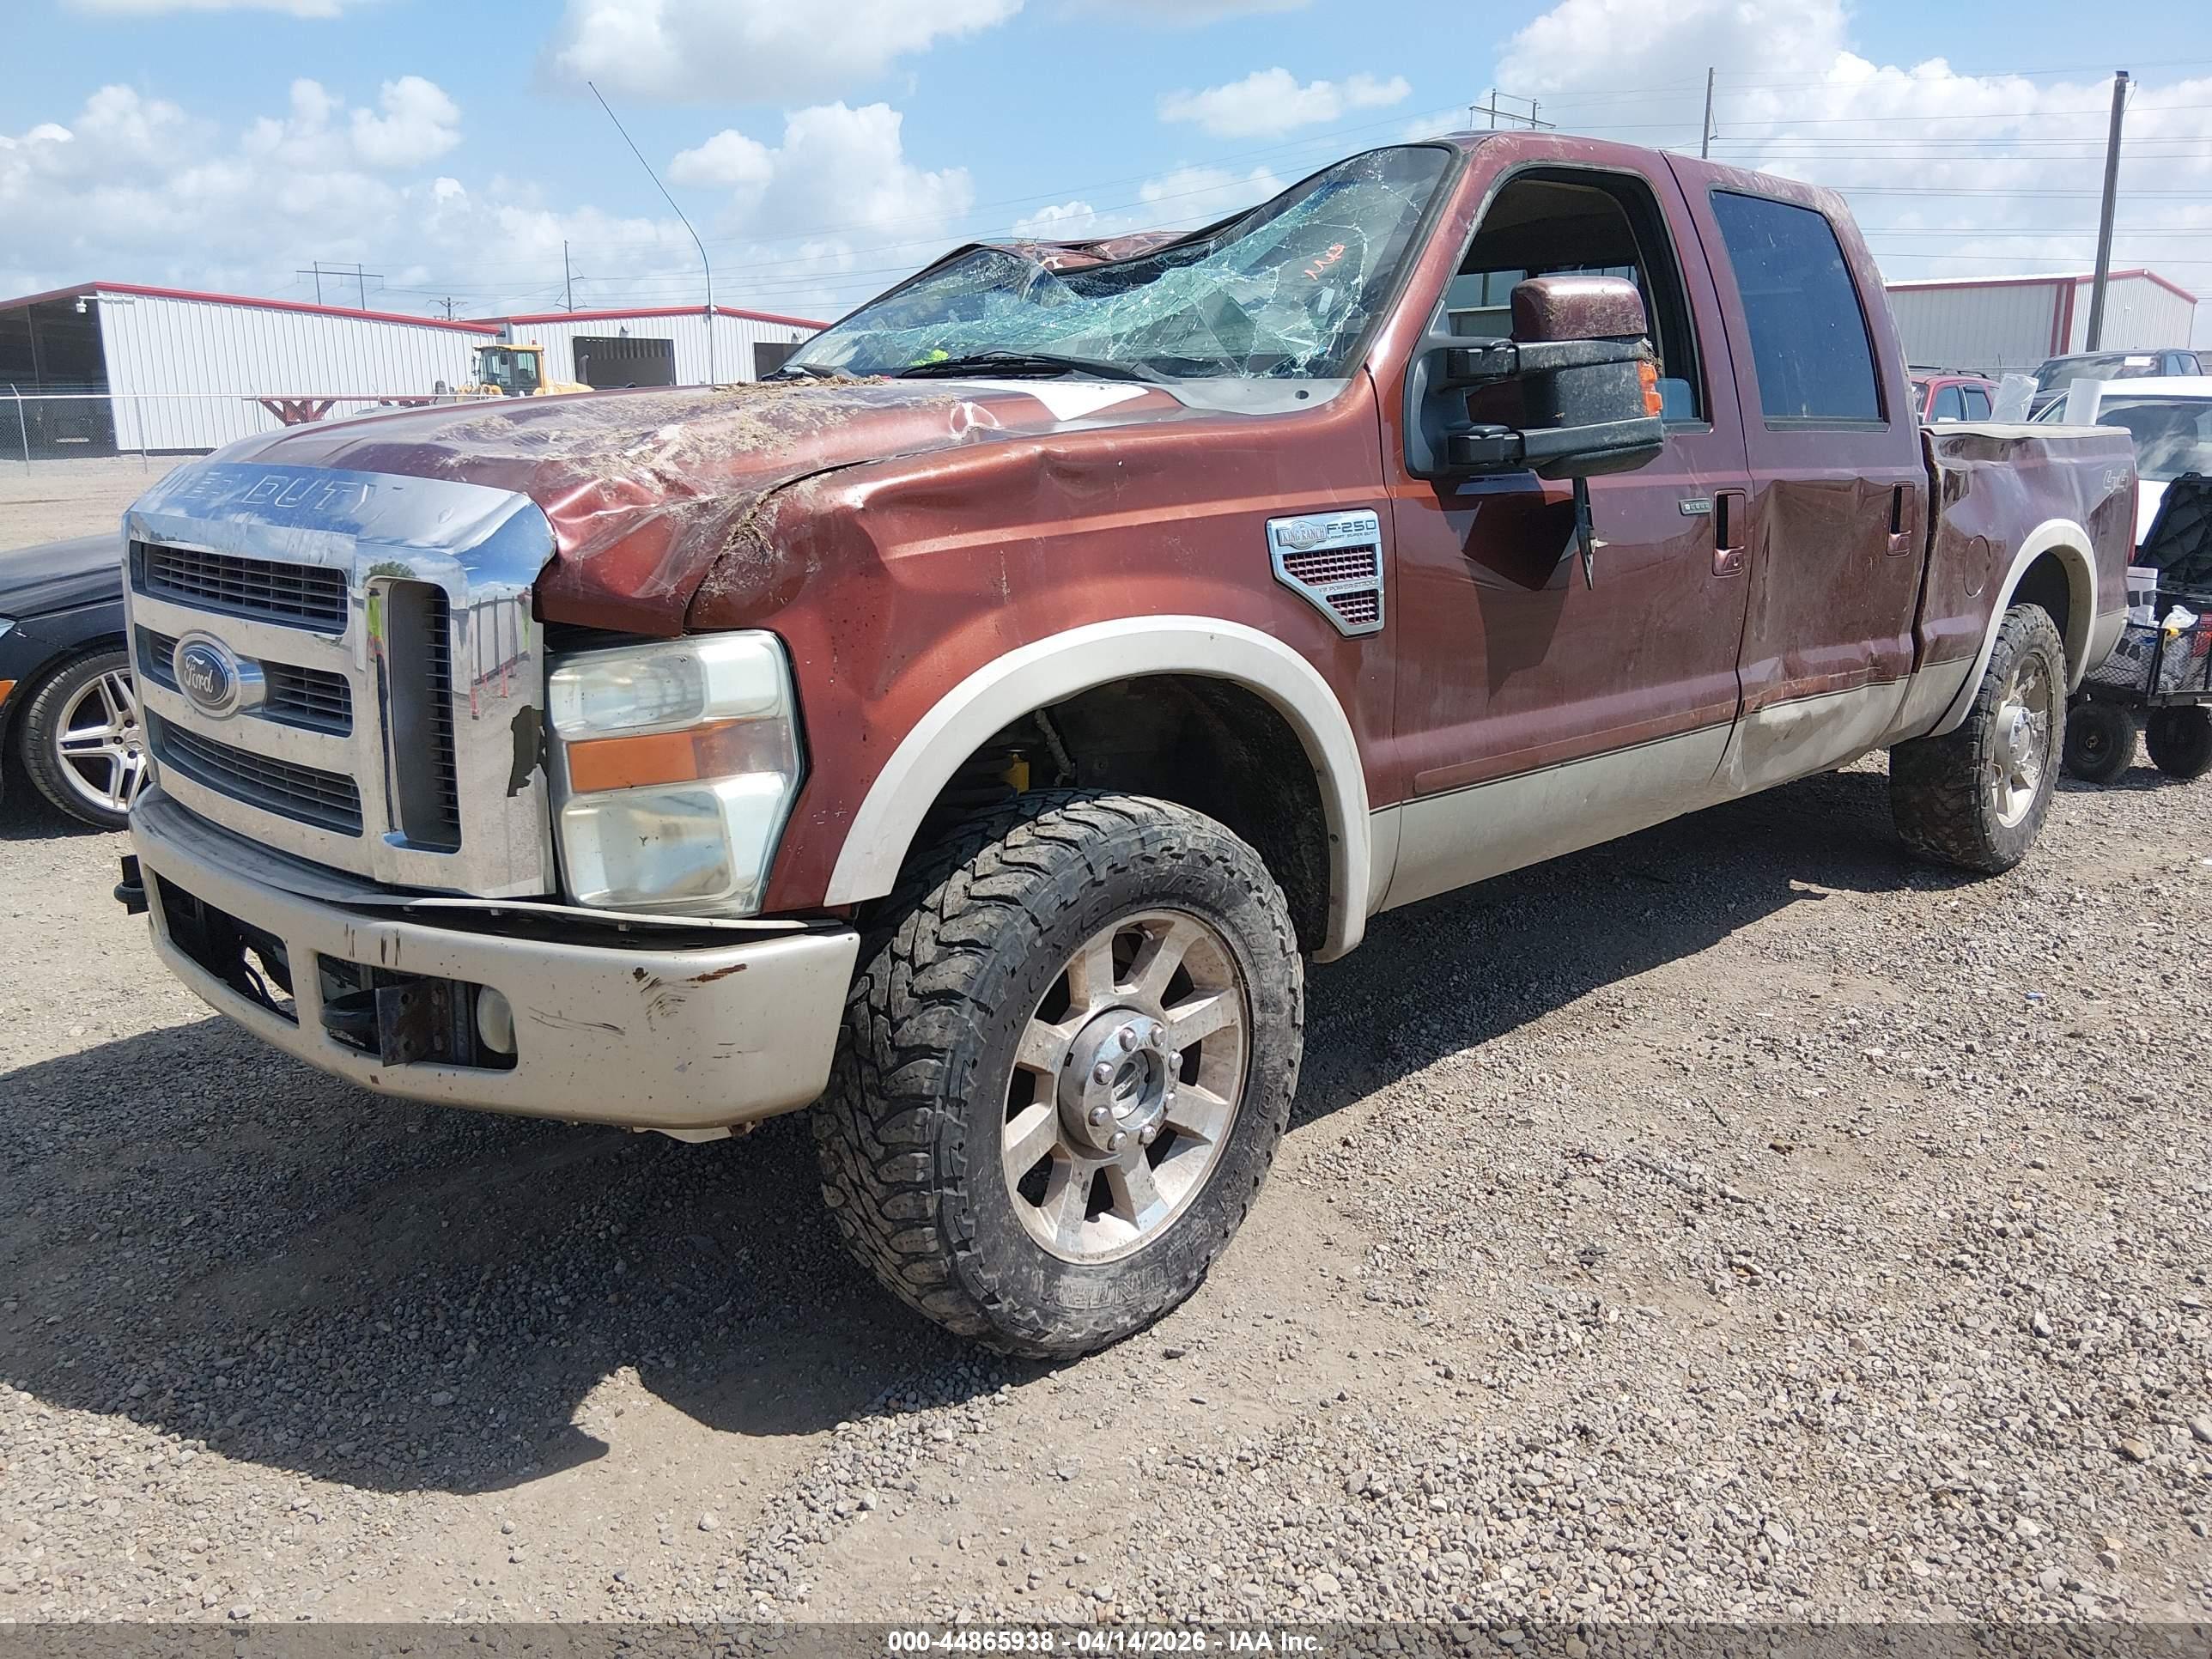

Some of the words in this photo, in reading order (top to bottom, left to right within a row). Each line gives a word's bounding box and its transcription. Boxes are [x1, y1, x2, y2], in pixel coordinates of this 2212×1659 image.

[1282, 529, 1301, 542] KING
[1301, 525, 1325, 540] RANCH
[1326, 520, 1376, 534] F-250
[183, 653, 214, 694] Ford
